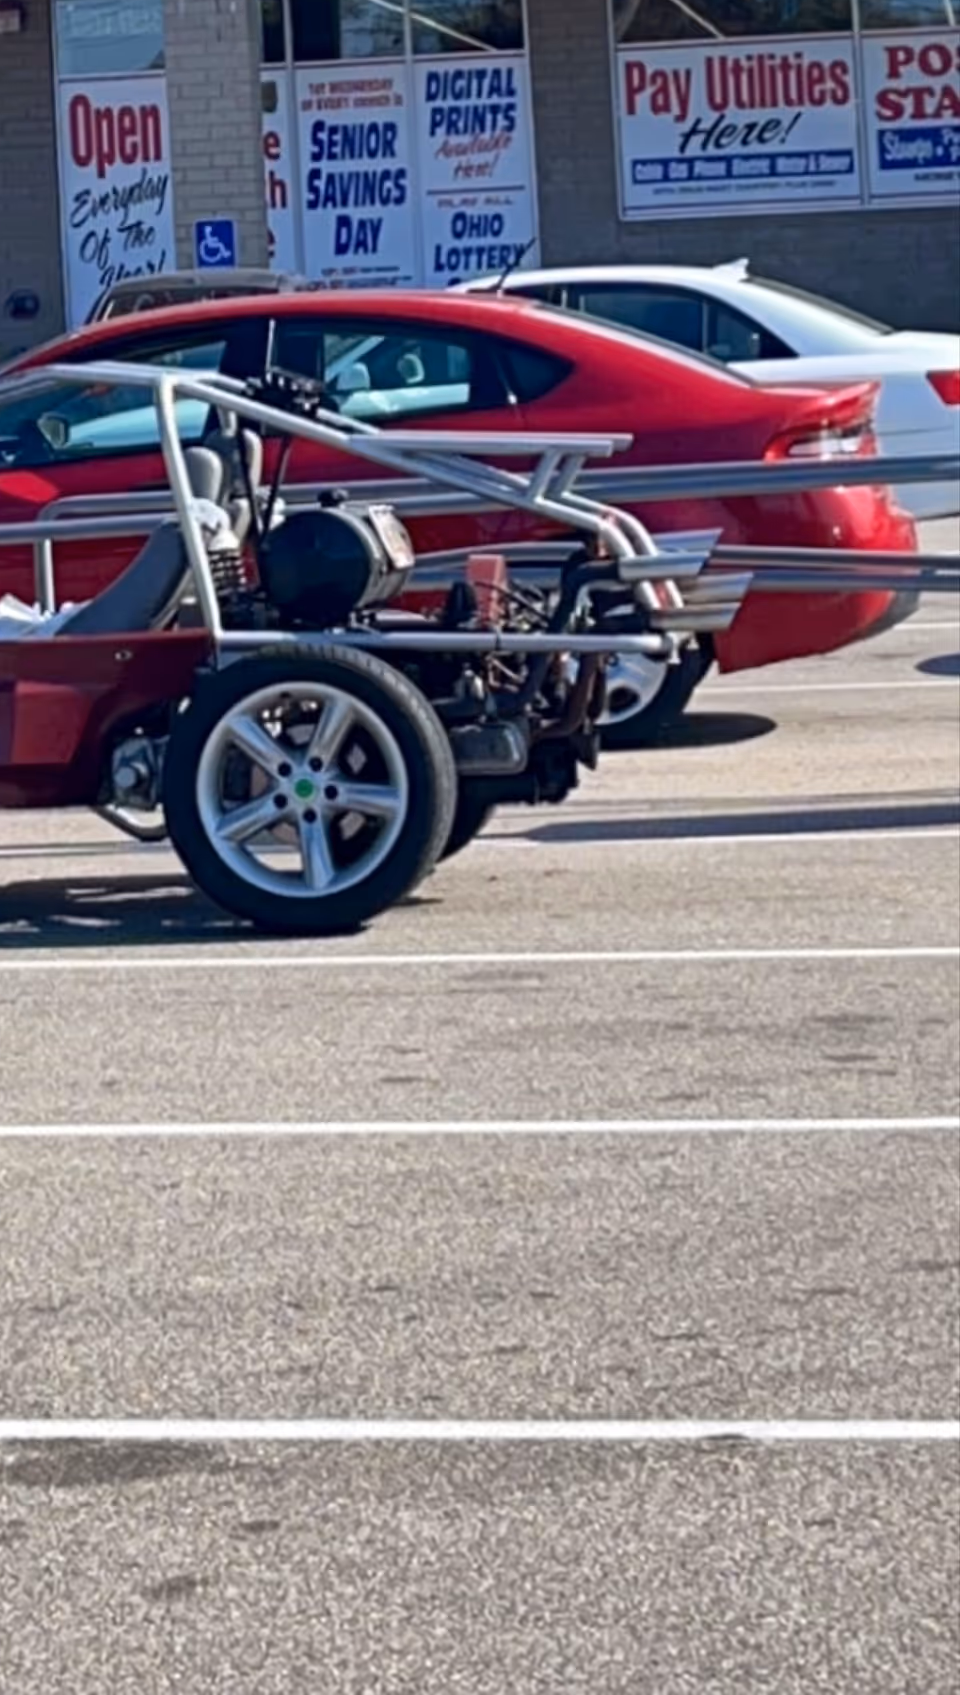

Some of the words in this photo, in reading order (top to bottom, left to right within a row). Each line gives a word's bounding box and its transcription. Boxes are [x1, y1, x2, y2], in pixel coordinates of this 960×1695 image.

[425, 68, 516, 102] DIGITAL
[625, 61, 691, 122] Pay
[705, 52, 850, 112] Utilities
[70, 94, 162, 179] Open
[310, 120, 398, 161] SENIOR
[429, 103, 516, 137] PRINTS
[679, 112, 802, 154] Here!
[70, 168, 168, 228] Everyday
[306, 167, 407, 210] SAVINGS
[80, 227, 111, 270] Of
[117, 220, 156, 251] The
[334, 214, 383, 256] DAY
[451, 211, 504, 240] OHIO
[434, 243, 527, 273] LOTTERY
